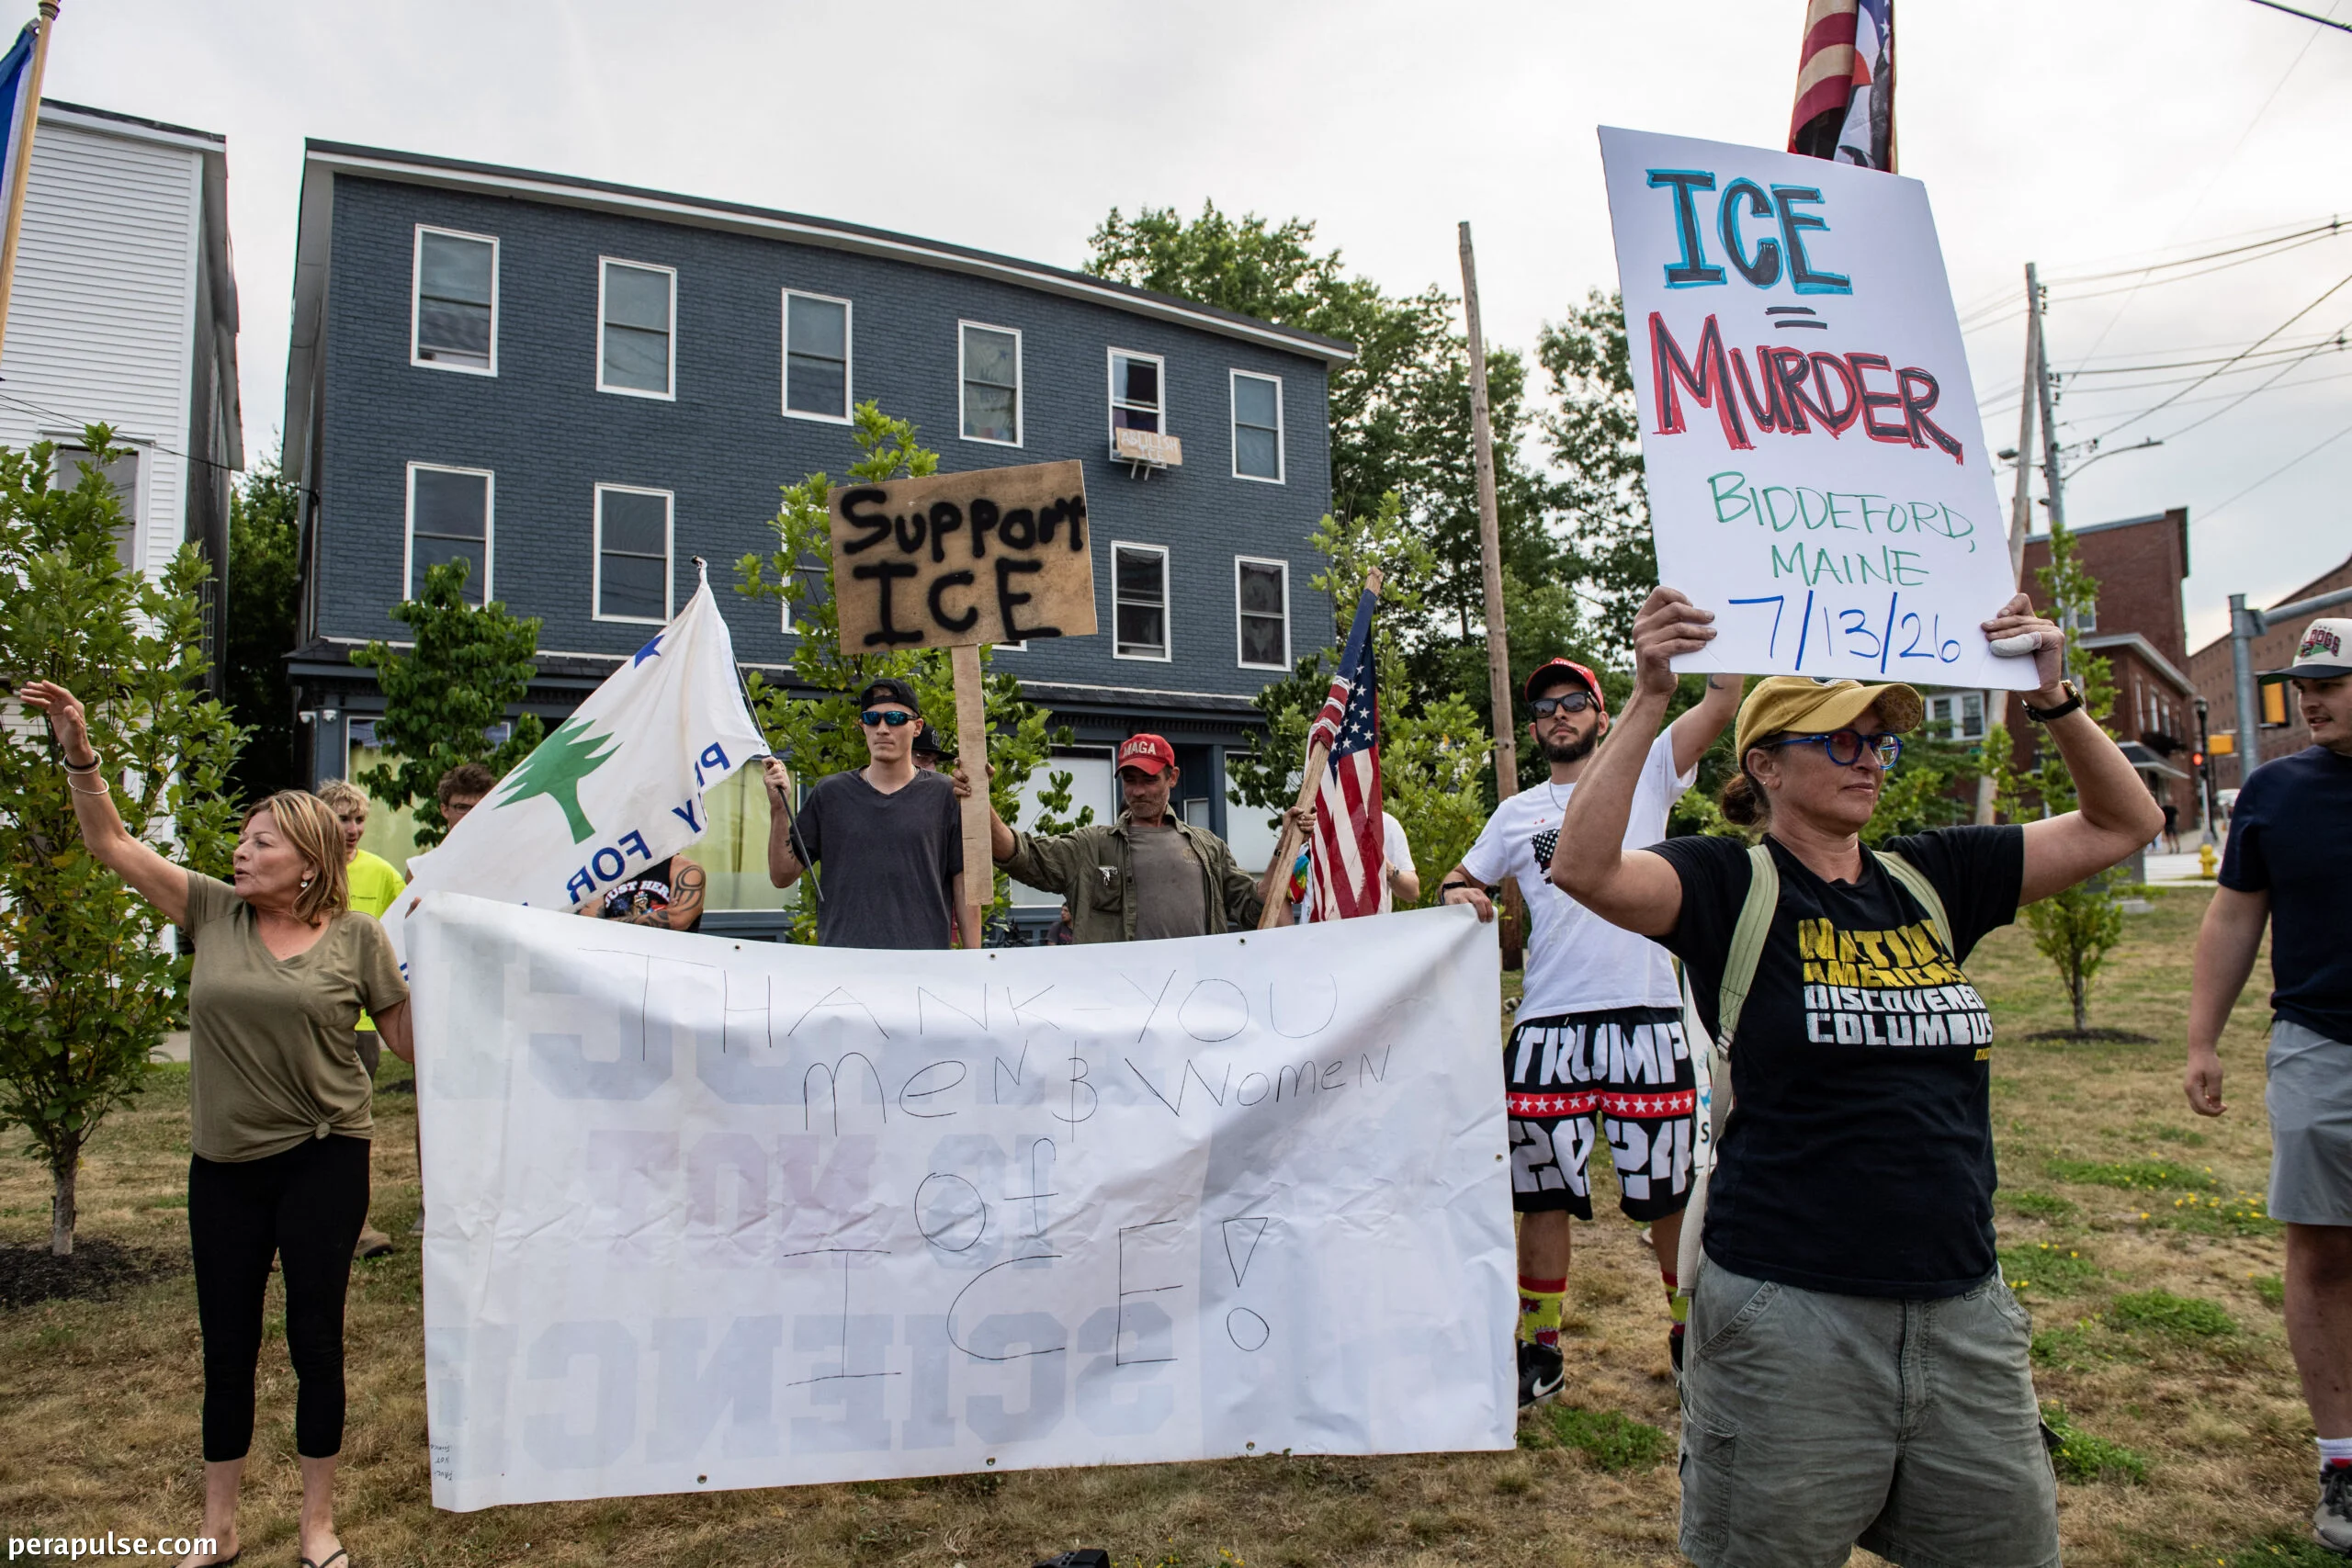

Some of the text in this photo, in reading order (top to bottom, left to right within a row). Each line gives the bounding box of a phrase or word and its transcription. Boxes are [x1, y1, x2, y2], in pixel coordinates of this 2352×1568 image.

[1645, 168, 1852, 295] ICE
[1648, 311, 1962, 465] MURDER
[1707, 470, 1975, 553] BIDDEFORD,
[1771, 542, 1929, 586] MAINE
[852, 557, 1062, 646] ICE
[1728, 590, 1962, 674] 7/13/26
[1122, 741, 1157, 758] MAGA
[605, 880, 671, 908] JUST HER
[1798, 918, 1951, 967] NATIV
[1804, 985, 1986, 1012] DISCOVERED
[1806, 1012, 1993, 1045] COLUMBUS
[1513, 1021, 1690, 1086] TRUMP
[1510, 1117, 1691, 1200] 2024
